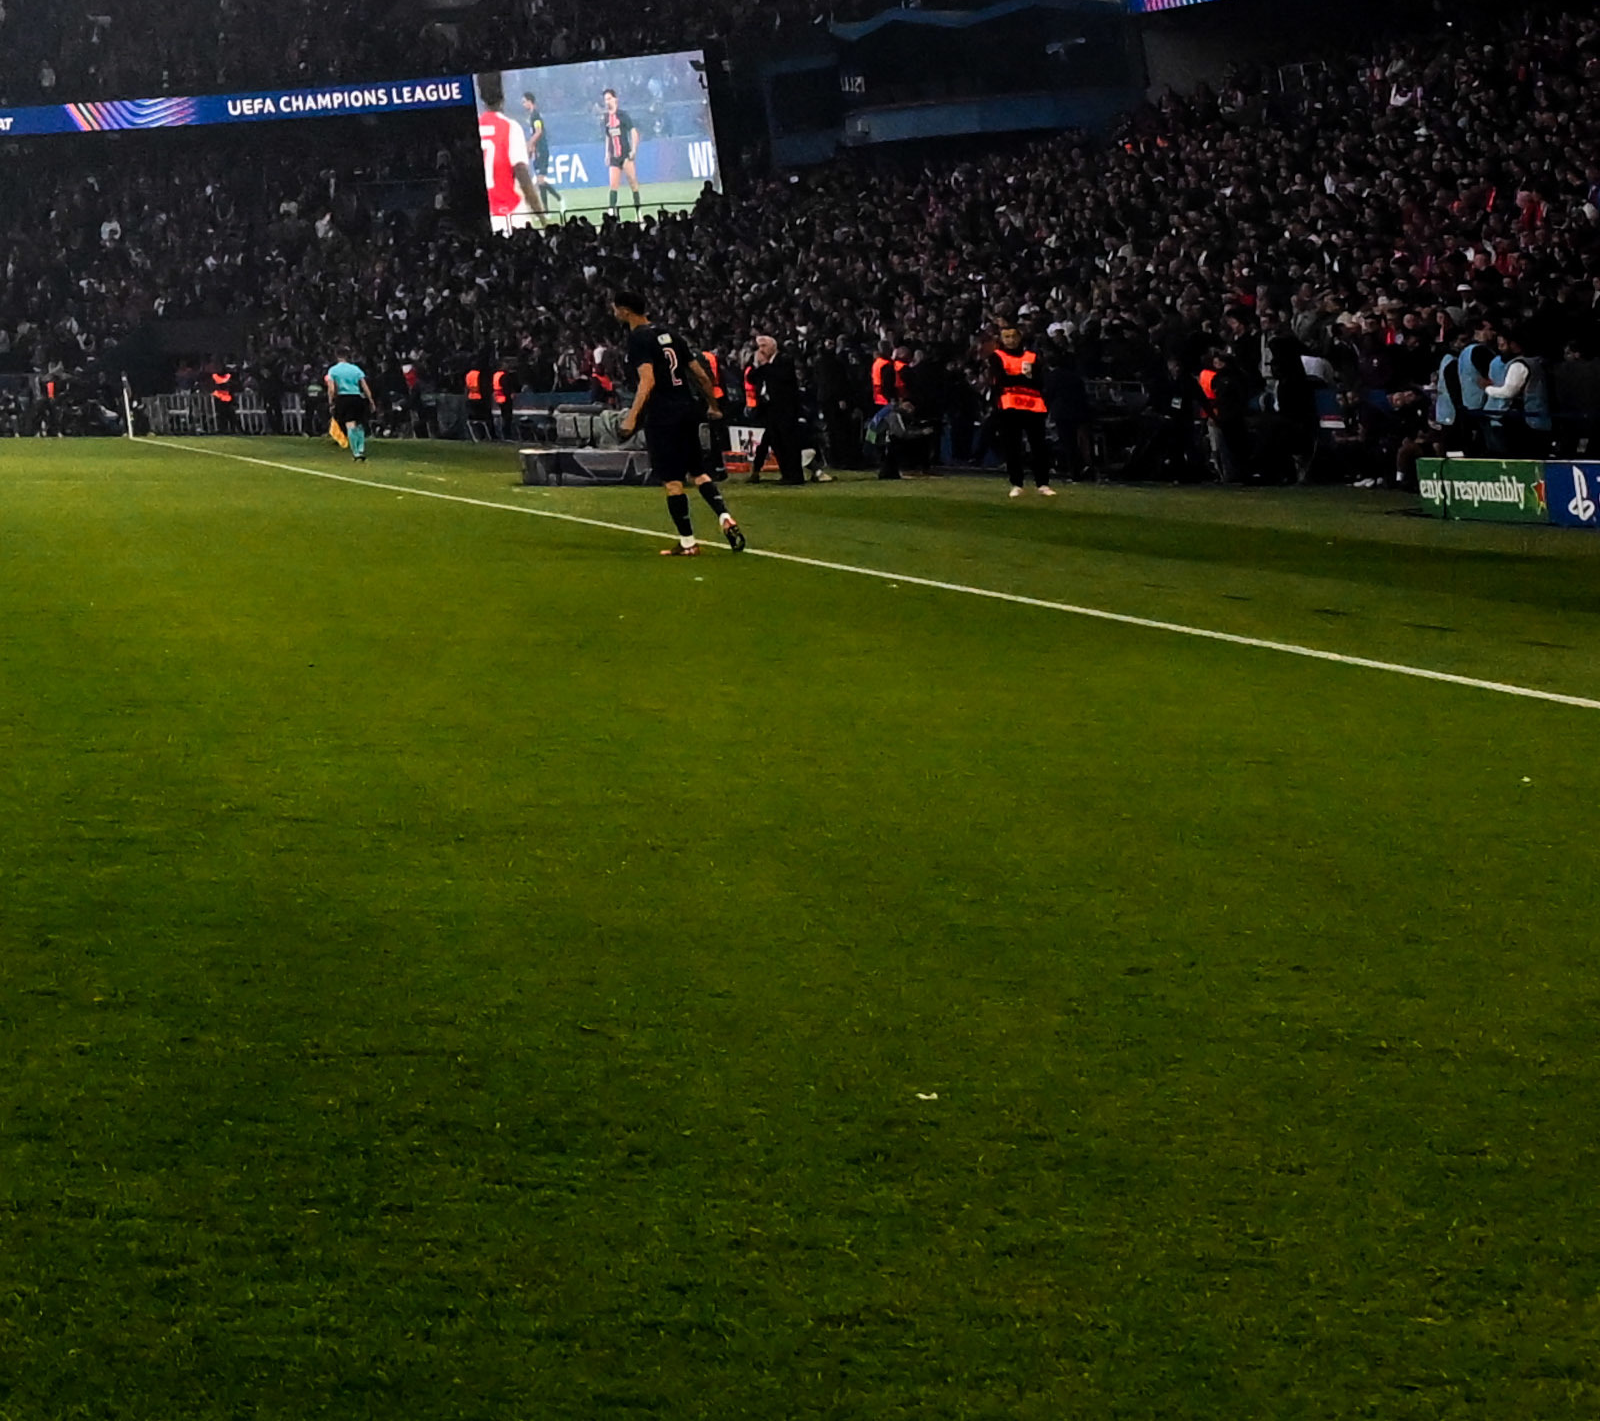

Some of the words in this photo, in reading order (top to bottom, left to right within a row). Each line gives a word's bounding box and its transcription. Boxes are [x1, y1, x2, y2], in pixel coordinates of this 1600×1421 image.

[227, 97, 276, 116] UEFA
[279, 89, 388, 112] CHAMPIONS
[391, 82, 462, 104] LEAGUE
[662, 347, 682, 386] 2
[1453, 475, 1525, 510] responsibly
